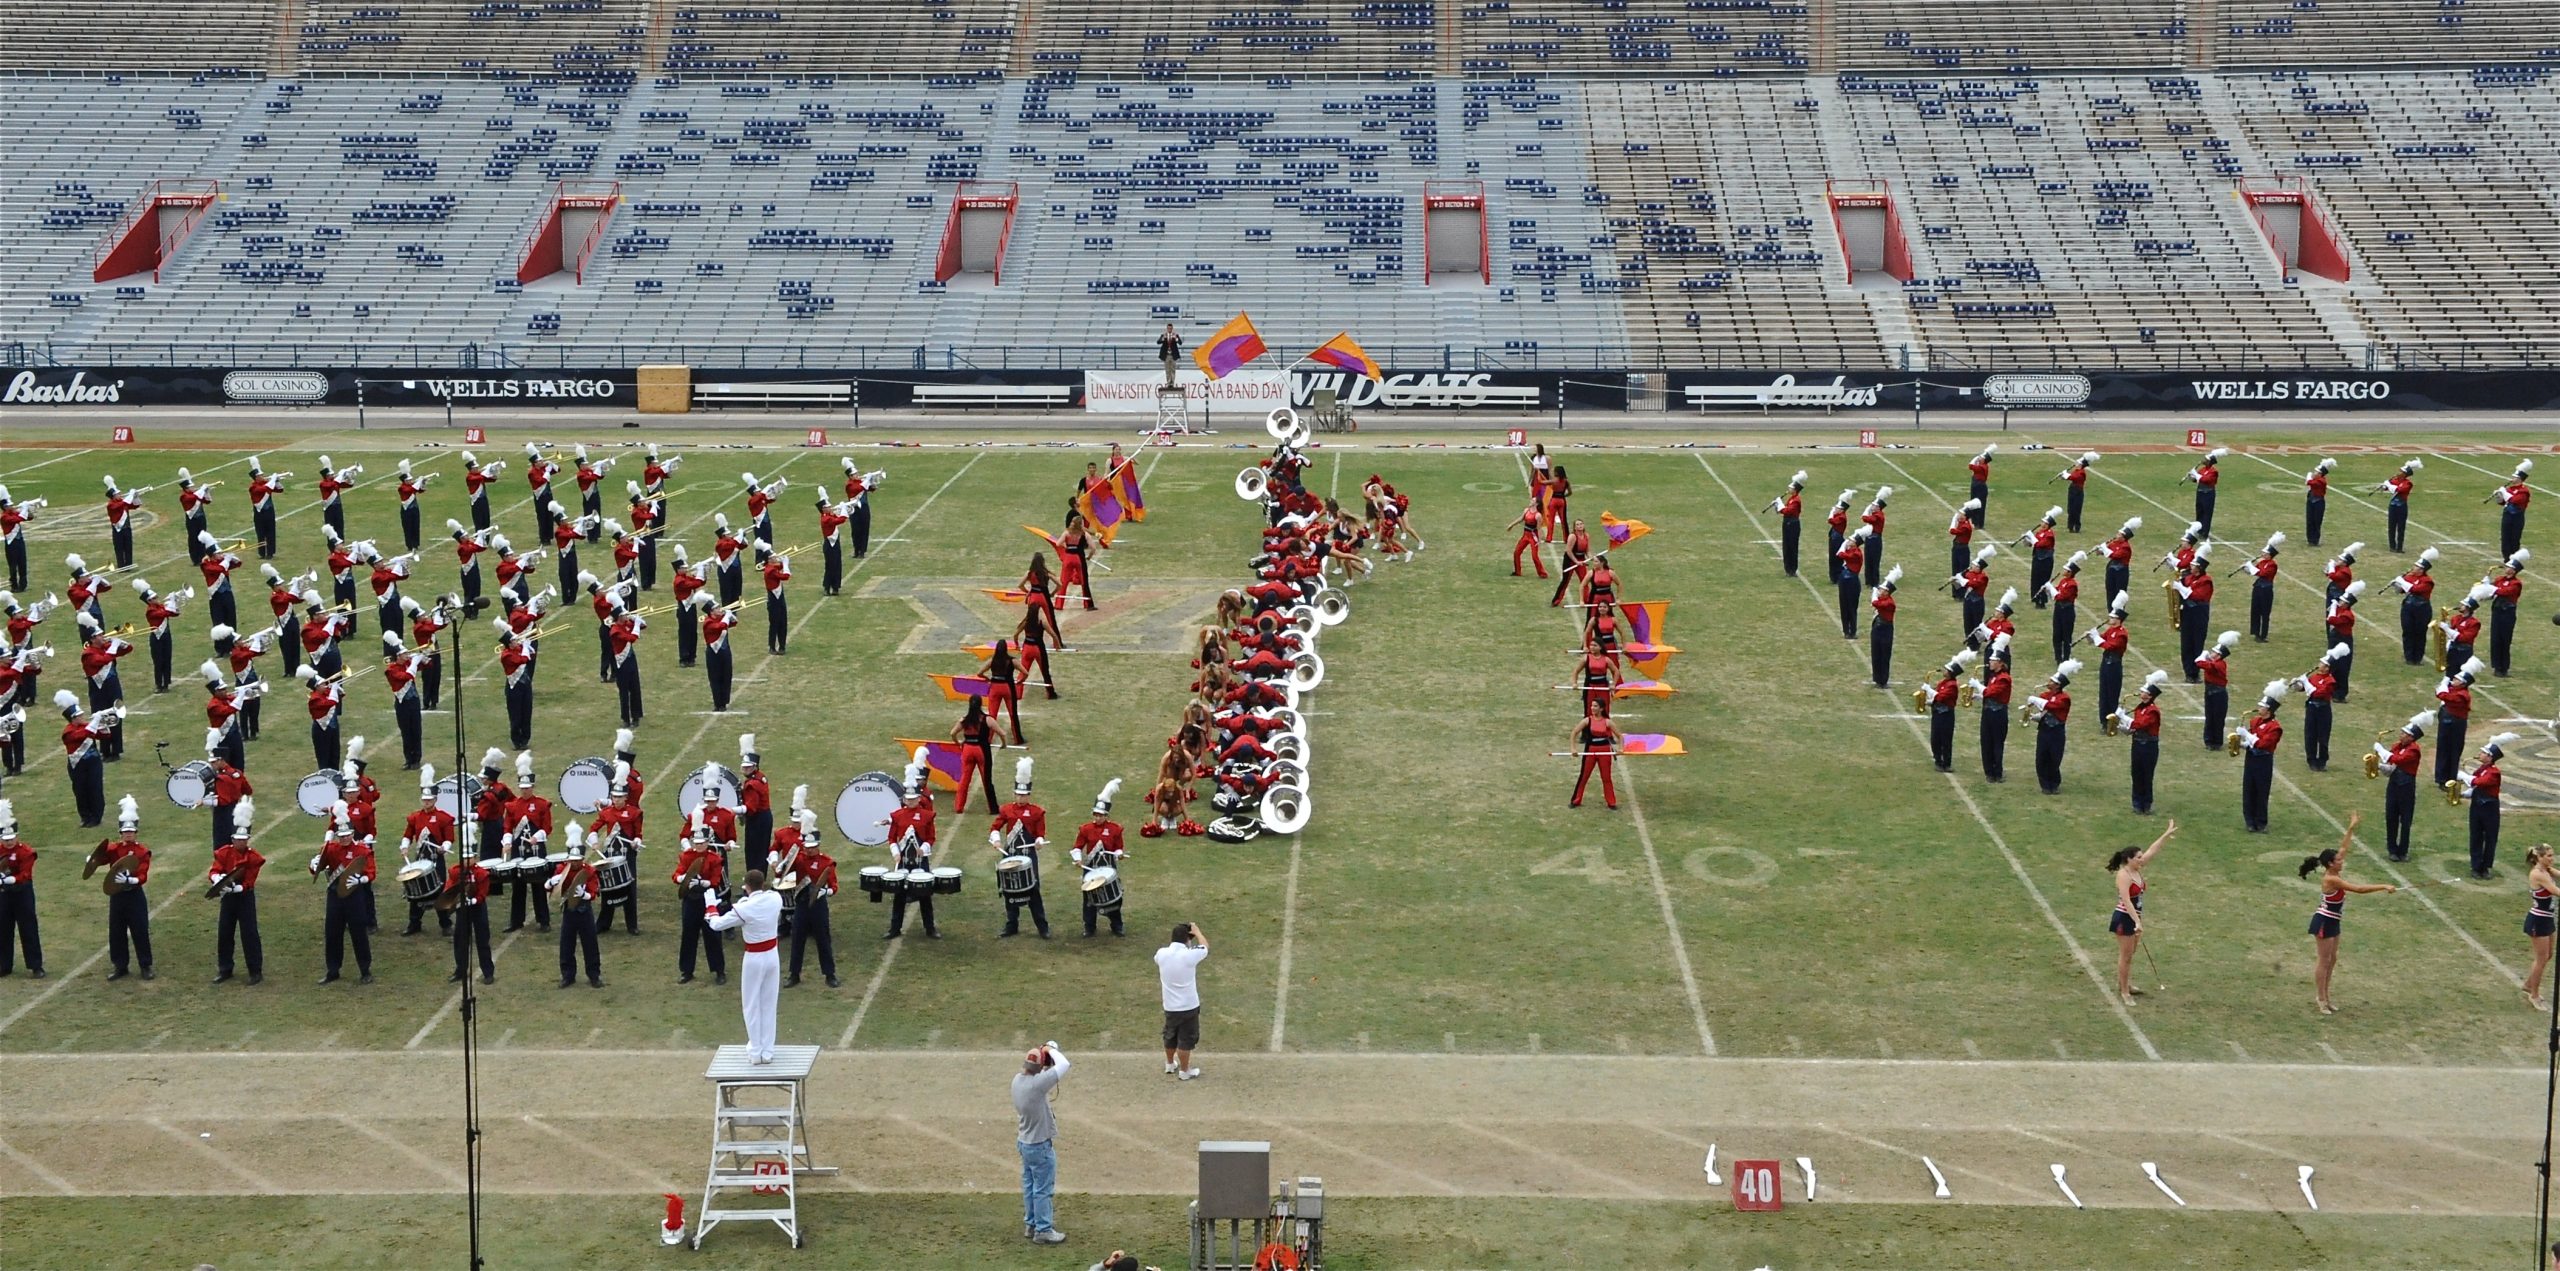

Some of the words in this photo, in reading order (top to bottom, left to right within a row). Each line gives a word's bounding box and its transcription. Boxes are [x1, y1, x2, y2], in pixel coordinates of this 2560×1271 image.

[2, 370, 125, 403] Bashas'
[234, 379, 259, 391] SOL
[262, 379, 318, 391] CASINOS
[426, 379, 520, 398] WELLS
[1090, 382, 1154, 400] UNIVERSITY
[1227, 383, 1259, 399] BAND
[1262, 383, 1285, 399] DAY
[1994, 383, 2019, 395] SOL
[2022, 383, 2080, 395] CASINOS
[2191, 381, 2290, 400] WELLS
[2294, 381, 2390, 400] FARGO
[114, 428, 128, 441] 20
[466, 428, 480, 442] 30
[1861, 431, 1875, 444] 30
[2190, 431, 2205, 444] 20
[755, 1163, 782, 1191] 50
[1740, 1168, 1774, 1203] 40
